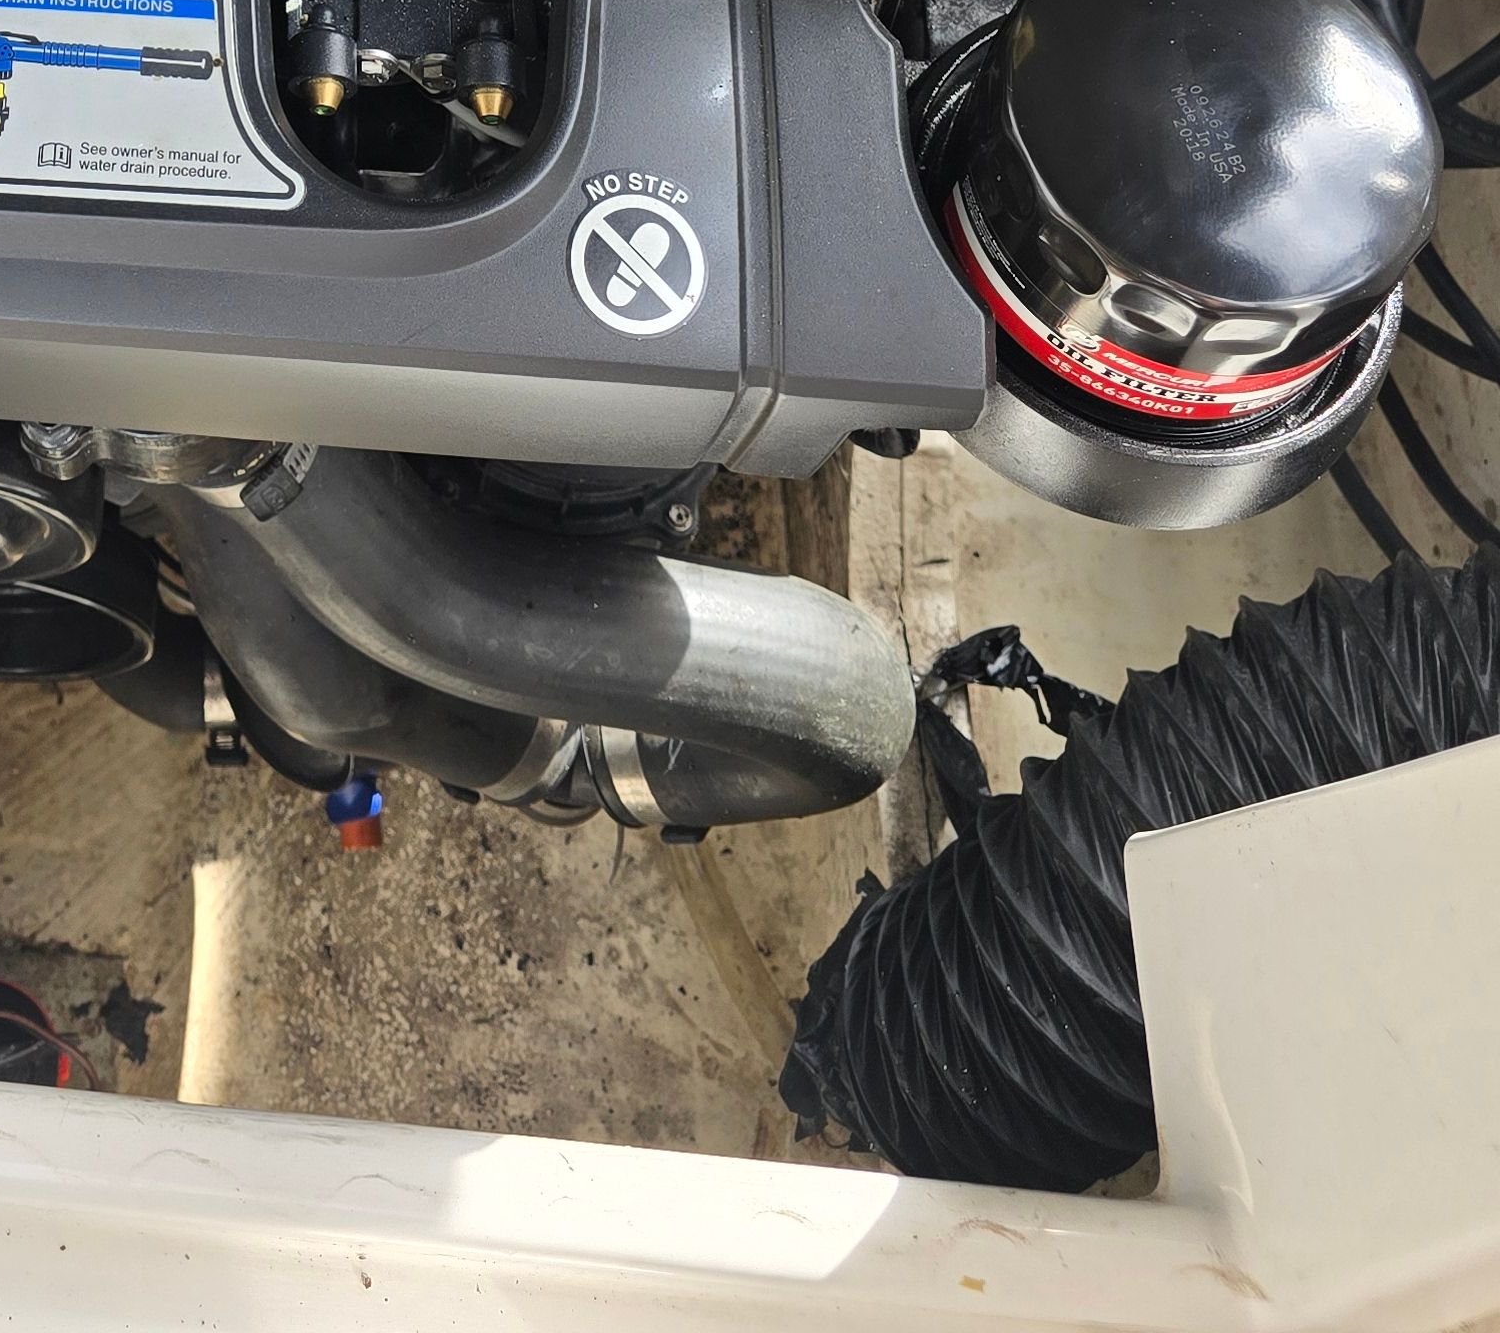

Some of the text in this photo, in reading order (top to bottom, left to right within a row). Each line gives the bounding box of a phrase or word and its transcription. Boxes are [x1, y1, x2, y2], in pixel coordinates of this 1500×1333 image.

[78, 158, 232, 180] water drain procedure.
[79, 141, 242, 165] See owner's manual for
[1209, 152, 1234, 184] USA
[585, 172, 690, 205] NO STEP
[1047, 333, 1095, 371] OIL
[1100, 366, 1219, 403] FILTER
[1047, 353, 1195, 416] 35-866340K01
